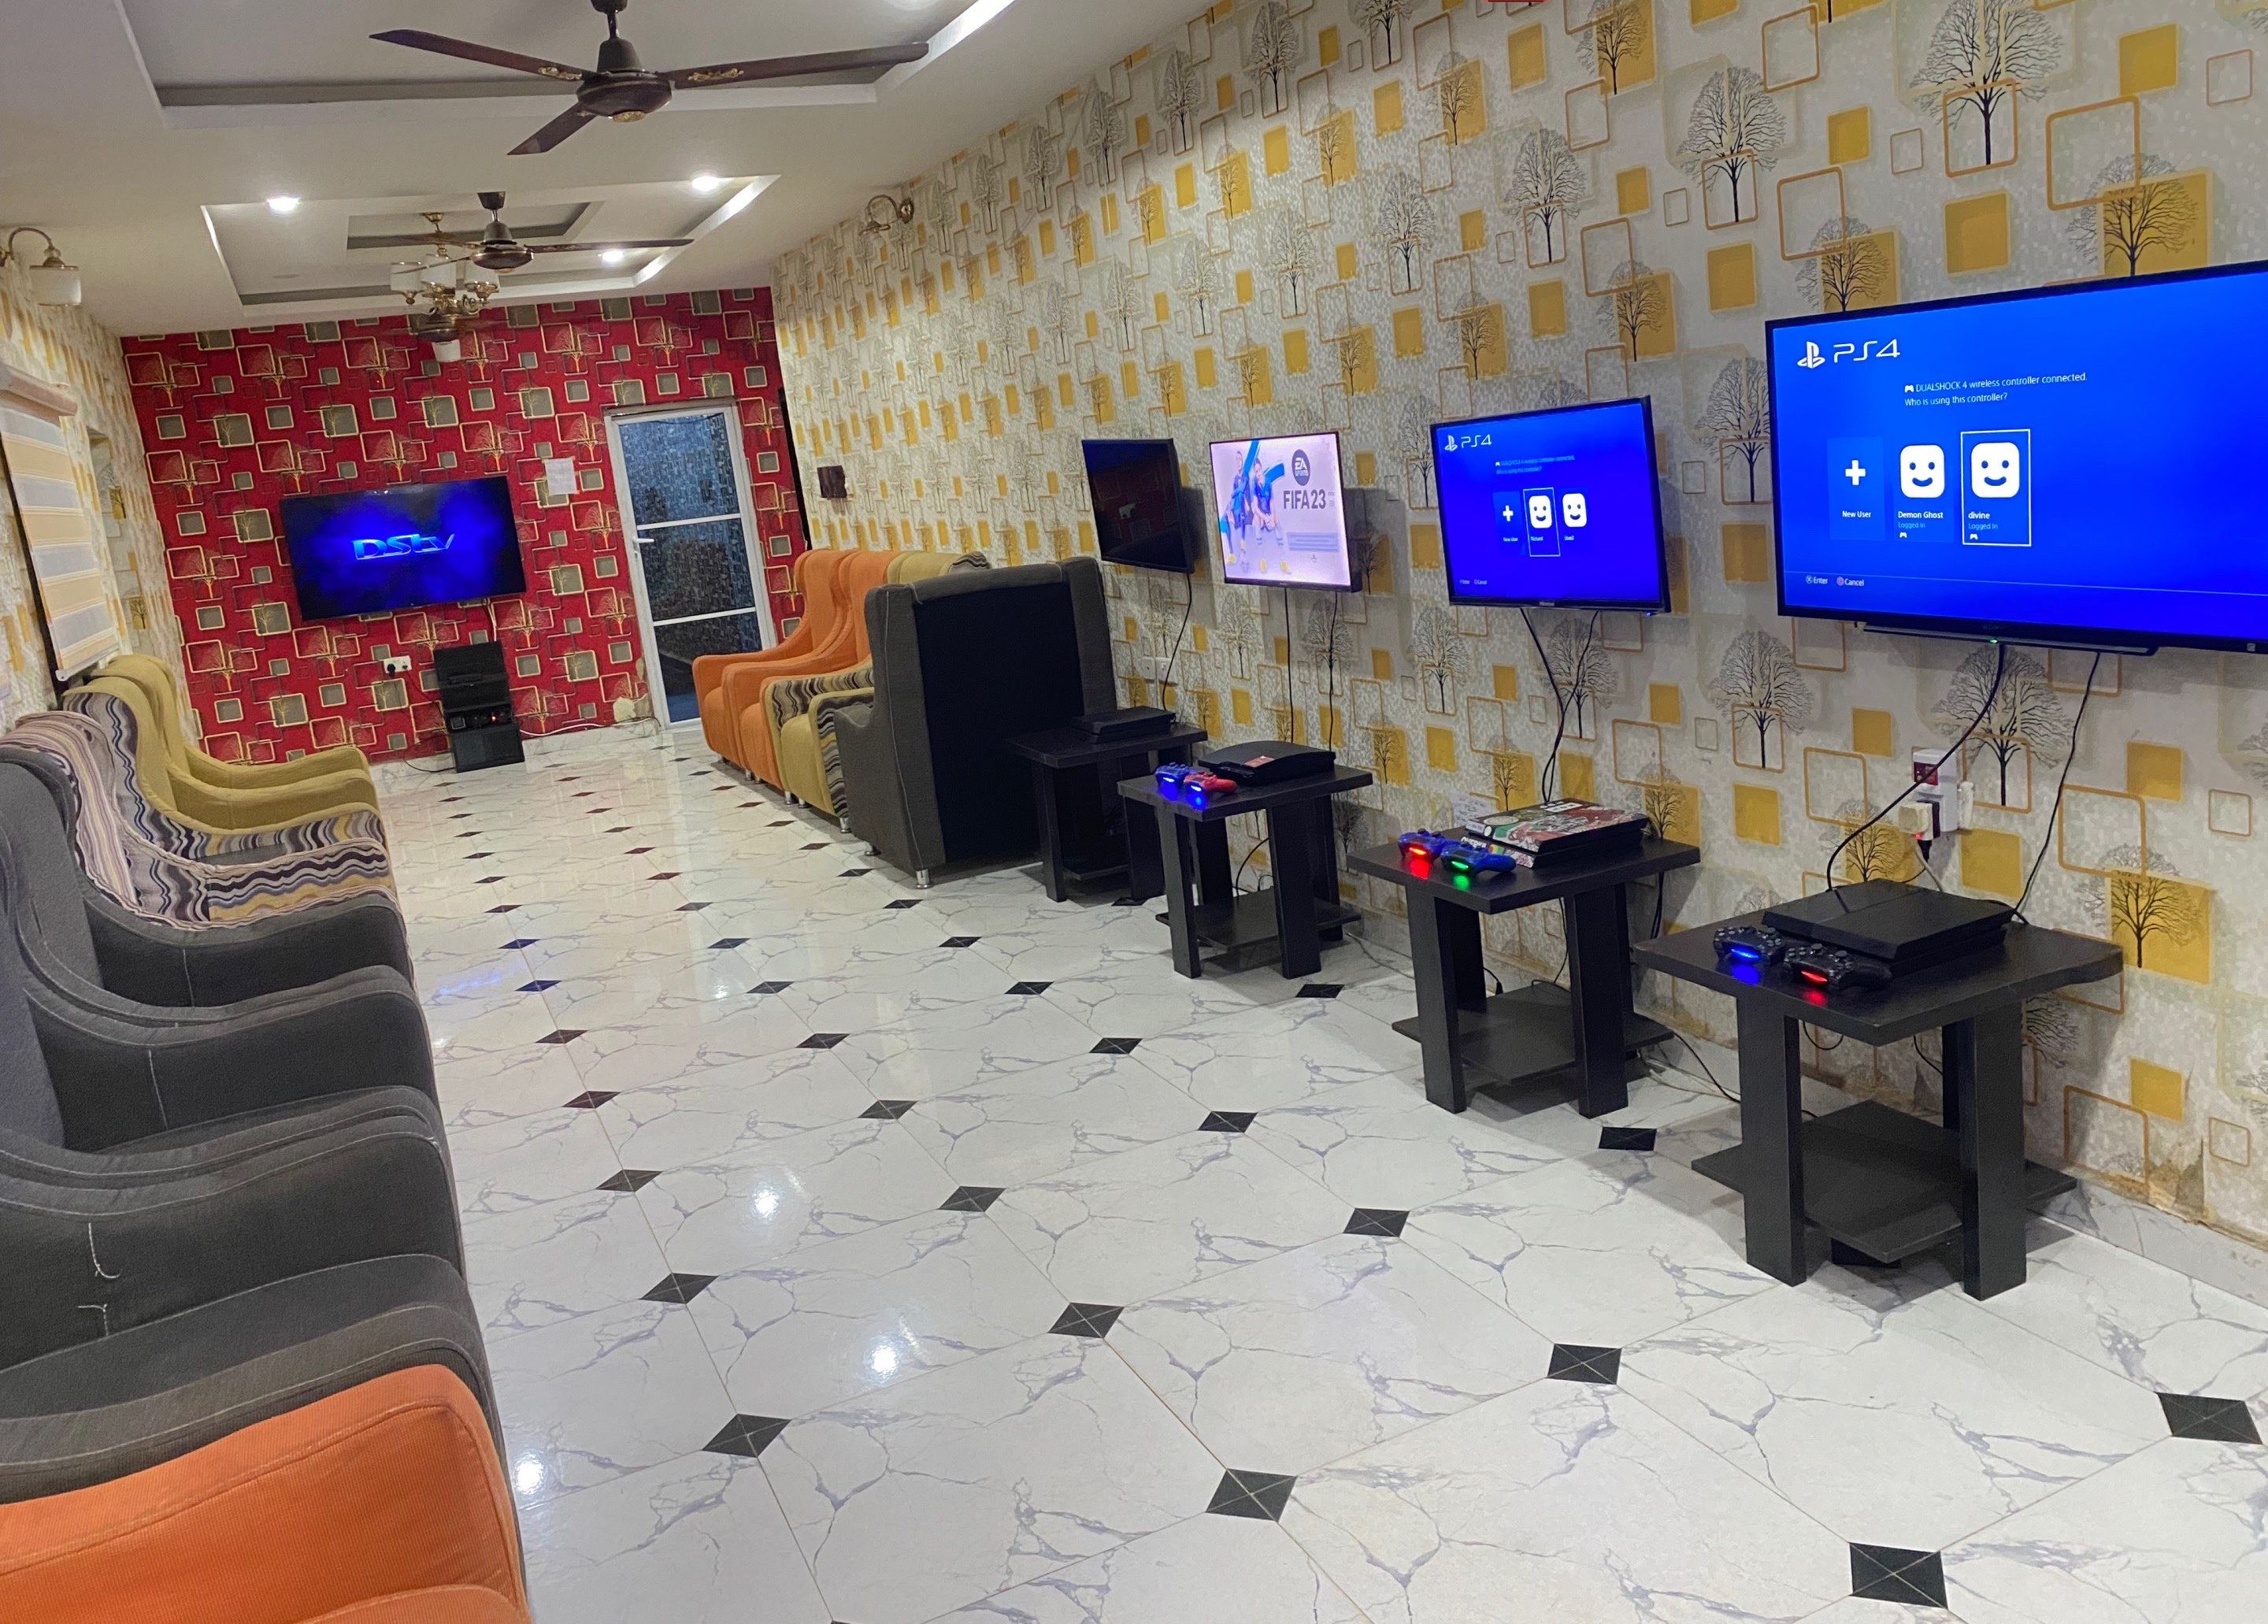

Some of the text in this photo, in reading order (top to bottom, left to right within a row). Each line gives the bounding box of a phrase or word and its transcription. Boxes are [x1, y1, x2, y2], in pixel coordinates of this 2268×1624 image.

[1833, 339, 1900, 363] PS4
[1916, 380, 1961, 392] DUALSHOCK
[1962, 380, 1968, 389] 4
[1970, 379, 2000, 388] wireless
[2002, 376, 2040, 387] controller
[1905, 397, 1922, 406] Who
[1930, 396, 1951, 406] using
[1952, 395, 1966, 404] this
[1967, 392, 2008, 402] controller?
[1461, 434, 1492, 448] PS4
[1295, 457, 1308, 470] EA
[1898, 521, 1920, 530] Logged
[1968, 522, 1992, 531] Logged
[1844, 578, 1865, 587] Cancel
